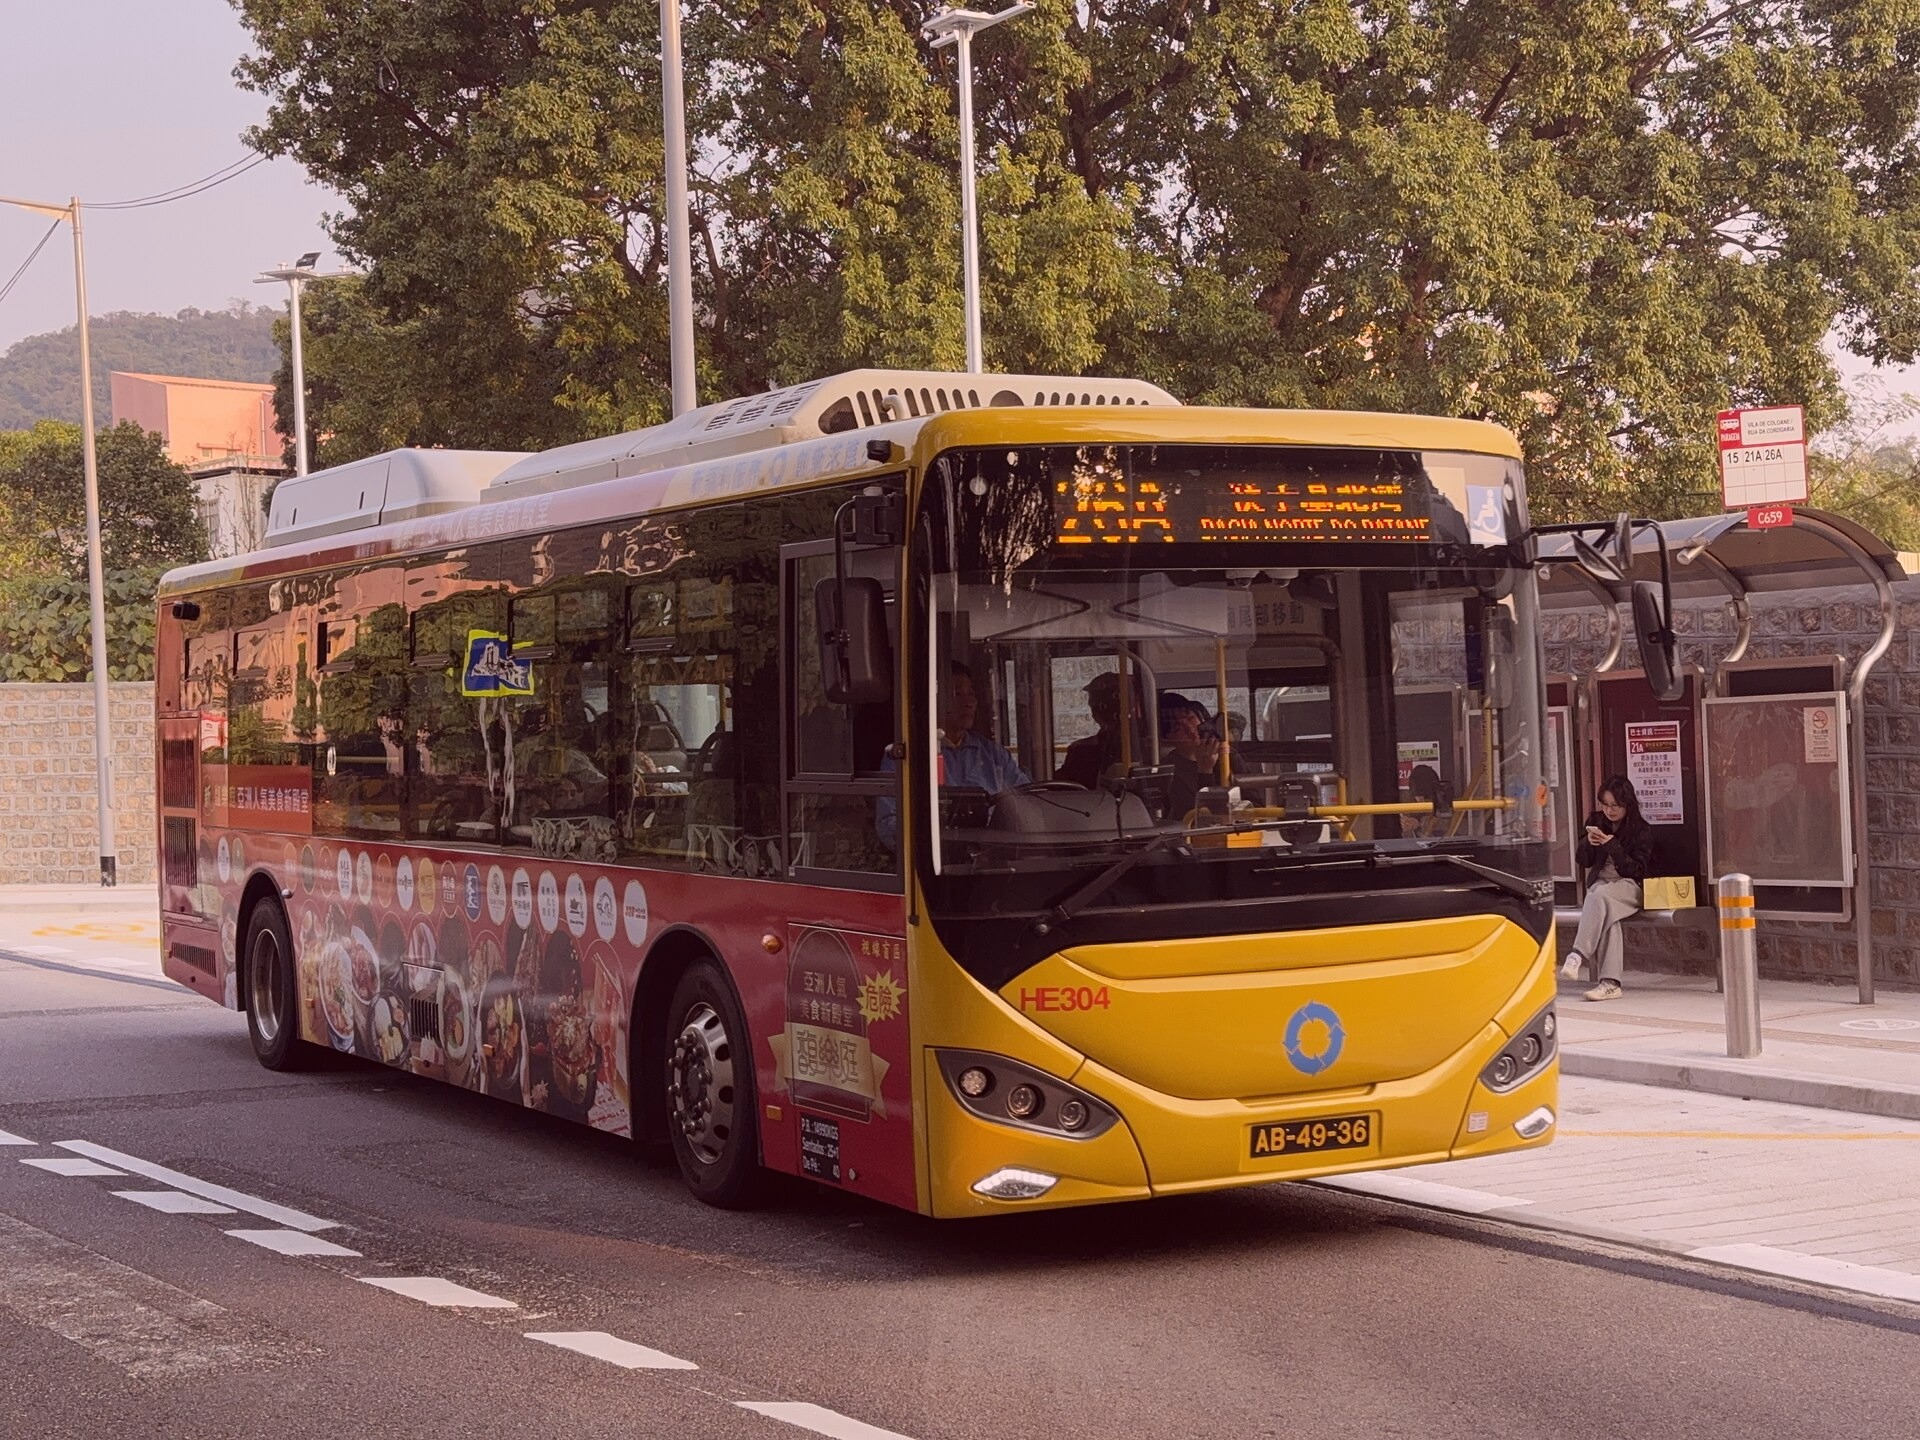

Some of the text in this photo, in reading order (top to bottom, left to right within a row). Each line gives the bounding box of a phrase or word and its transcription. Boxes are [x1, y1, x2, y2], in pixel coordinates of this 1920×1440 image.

[1766, 419, 1790, 427] COLOANE
[1727, 449, 1783, 464] 15 21A 26A
[1757, 511, 1783, 524] C659
[1631, 742, 1644, 753] 21A
[803, 971, 848, 999] 亞洲人氣
[865, 985, 893, 1014] 危險
[1020, 986, 1111, 1012] HE304
[799, 998, 854, 1028] 美食新殿堂
[1255, 1119, 1367, 1153] AB-49-36
